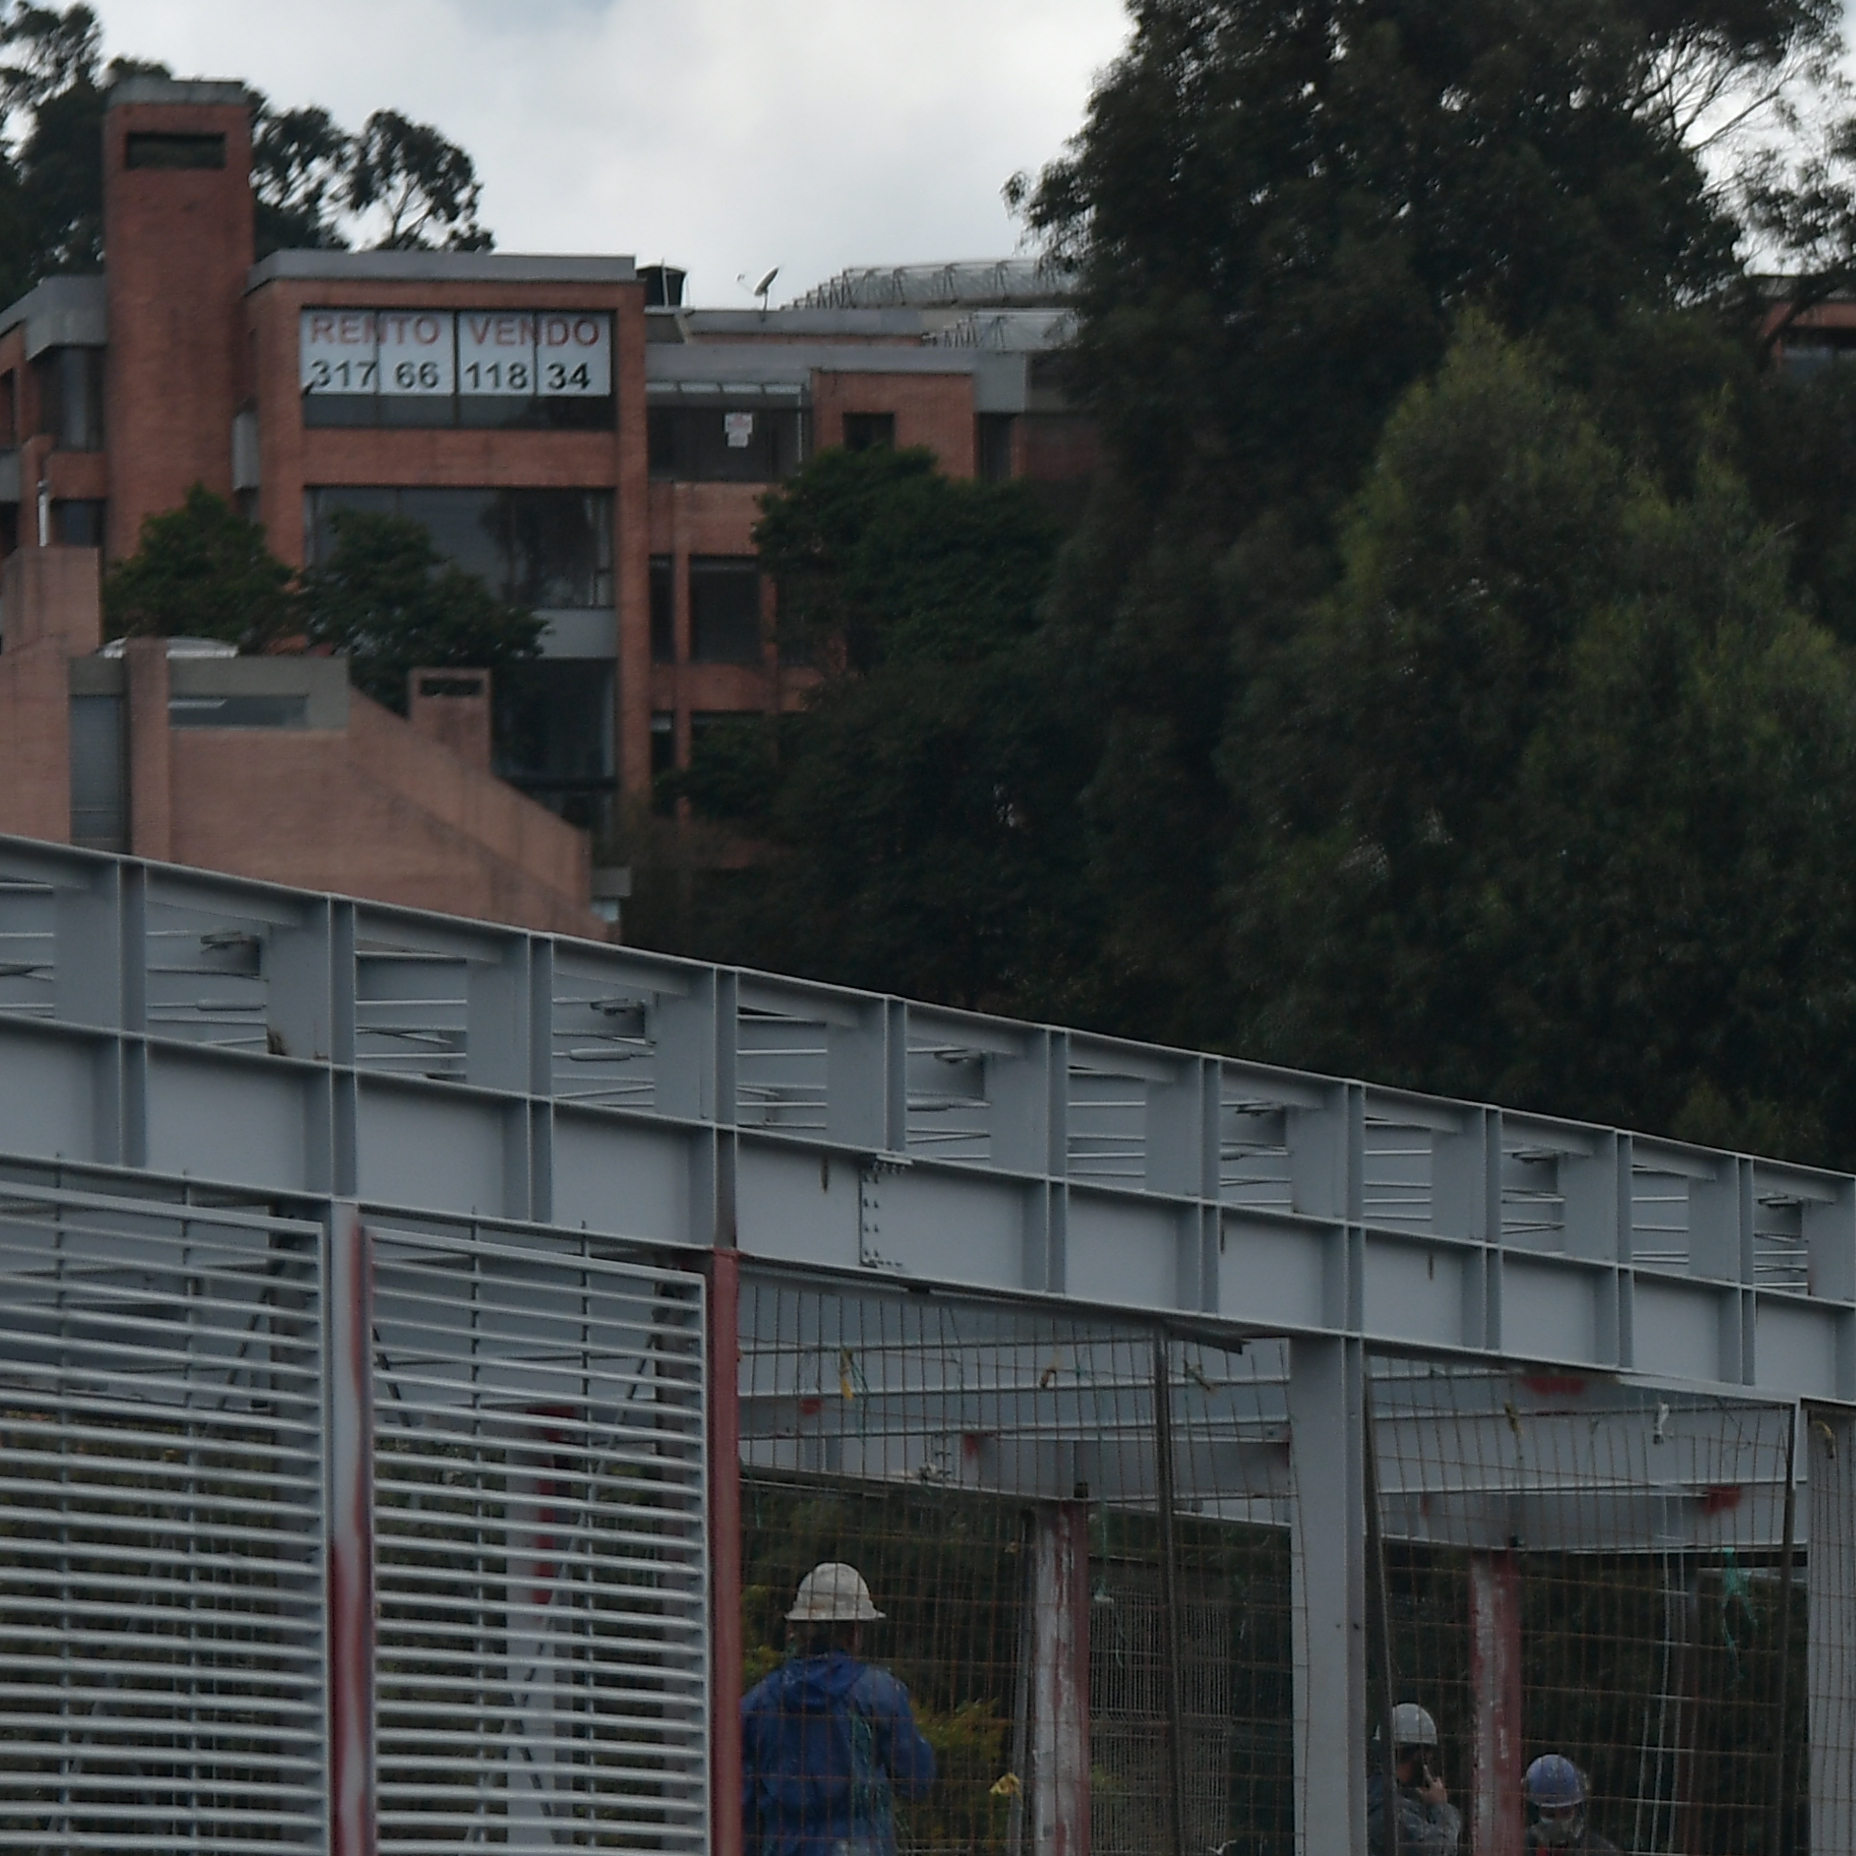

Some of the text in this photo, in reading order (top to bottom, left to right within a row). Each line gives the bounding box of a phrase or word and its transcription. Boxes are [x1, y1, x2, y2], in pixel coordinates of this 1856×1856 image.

[310, 316, 600, 347] RENTO VENDO
[311, 360, 590, 391] 317 66 118 34
